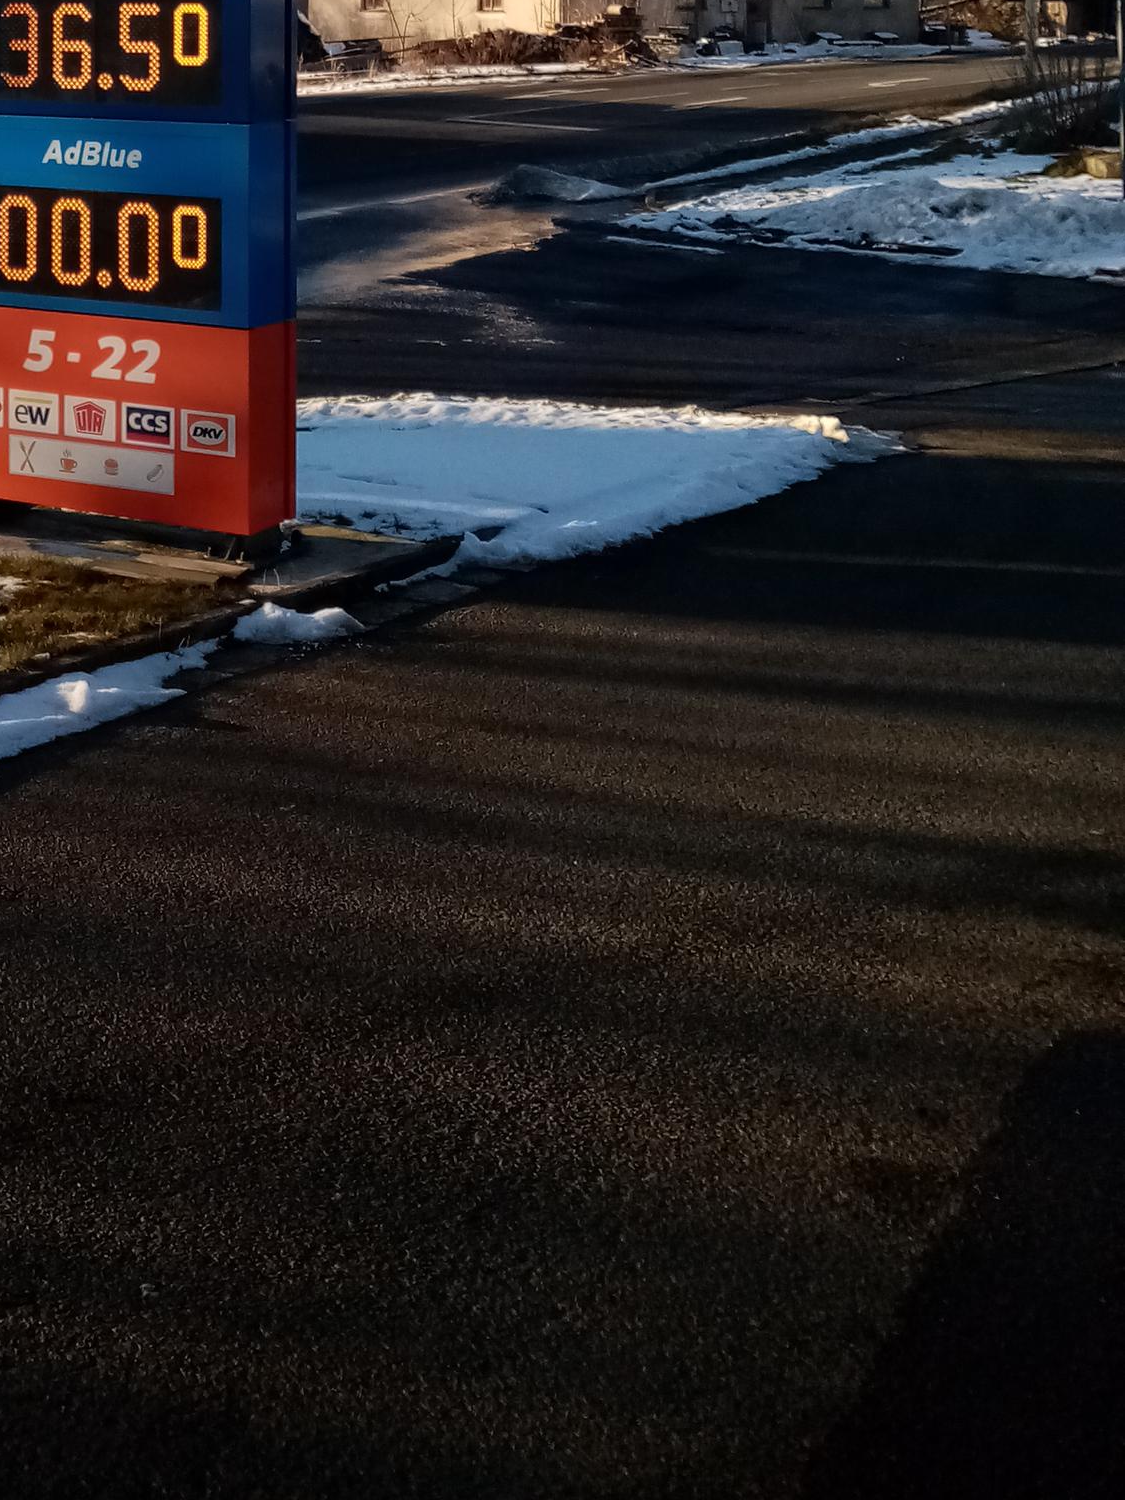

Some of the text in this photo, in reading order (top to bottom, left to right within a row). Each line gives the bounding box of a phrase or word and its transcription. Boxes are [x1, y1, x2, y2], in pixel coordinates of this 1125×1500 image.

[0, 2, 209, 92] 36.50
[42, 139, 142, 168] AdBlue
[23, 329, 56, 373] 5
[90, 335, 161, 384] 22
[128, 412, 168, 433] CCS
[192, 426, 223, 440] DKV
